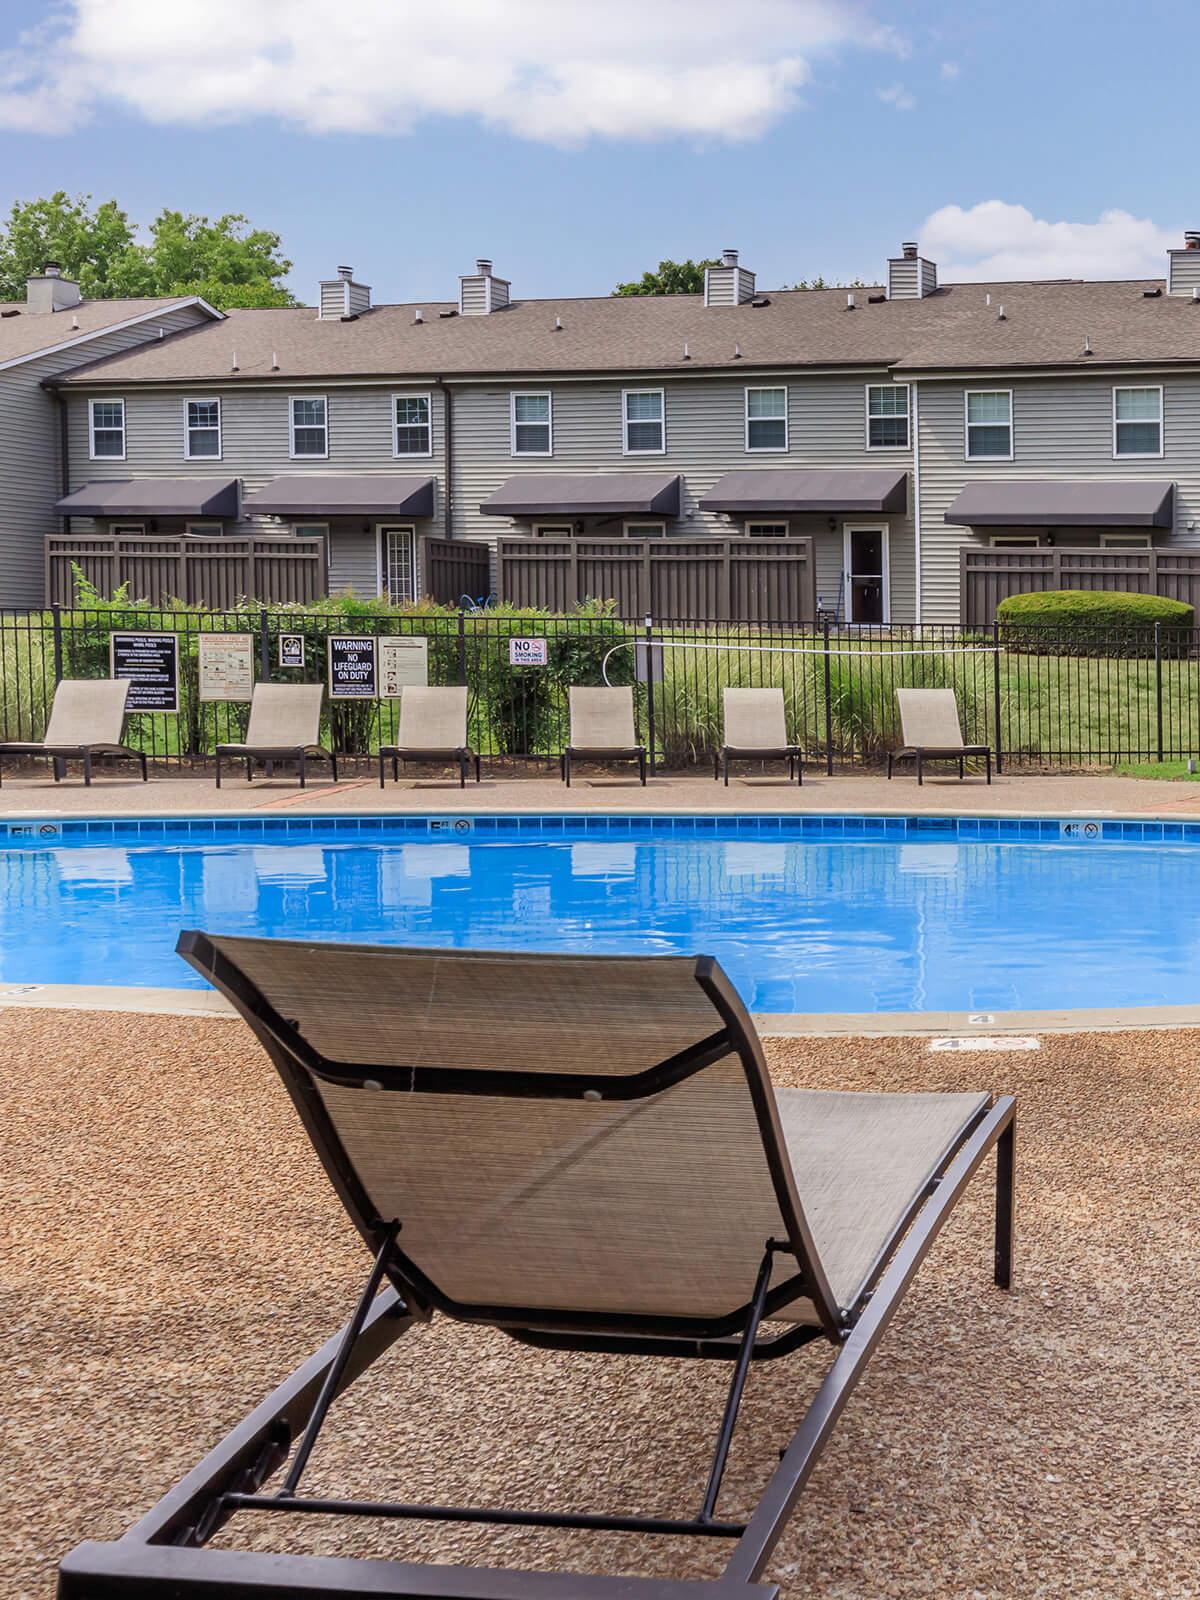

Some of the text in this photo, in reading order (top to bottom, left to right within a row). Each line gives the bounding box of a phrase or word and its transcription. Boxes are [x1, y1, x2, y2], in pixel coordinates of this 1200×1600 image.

[333, 641, 373, 651] WARNING
[515, 641, 530, 651] NO
[347, 653, 359, 662] NO
[333, 662, 373, 671] LIFEGUARD
[338, 671, 369, 680] ON DUTY
[971, 1015, 989, 1023] 4
[937, 1040, 960, 1048] 4
